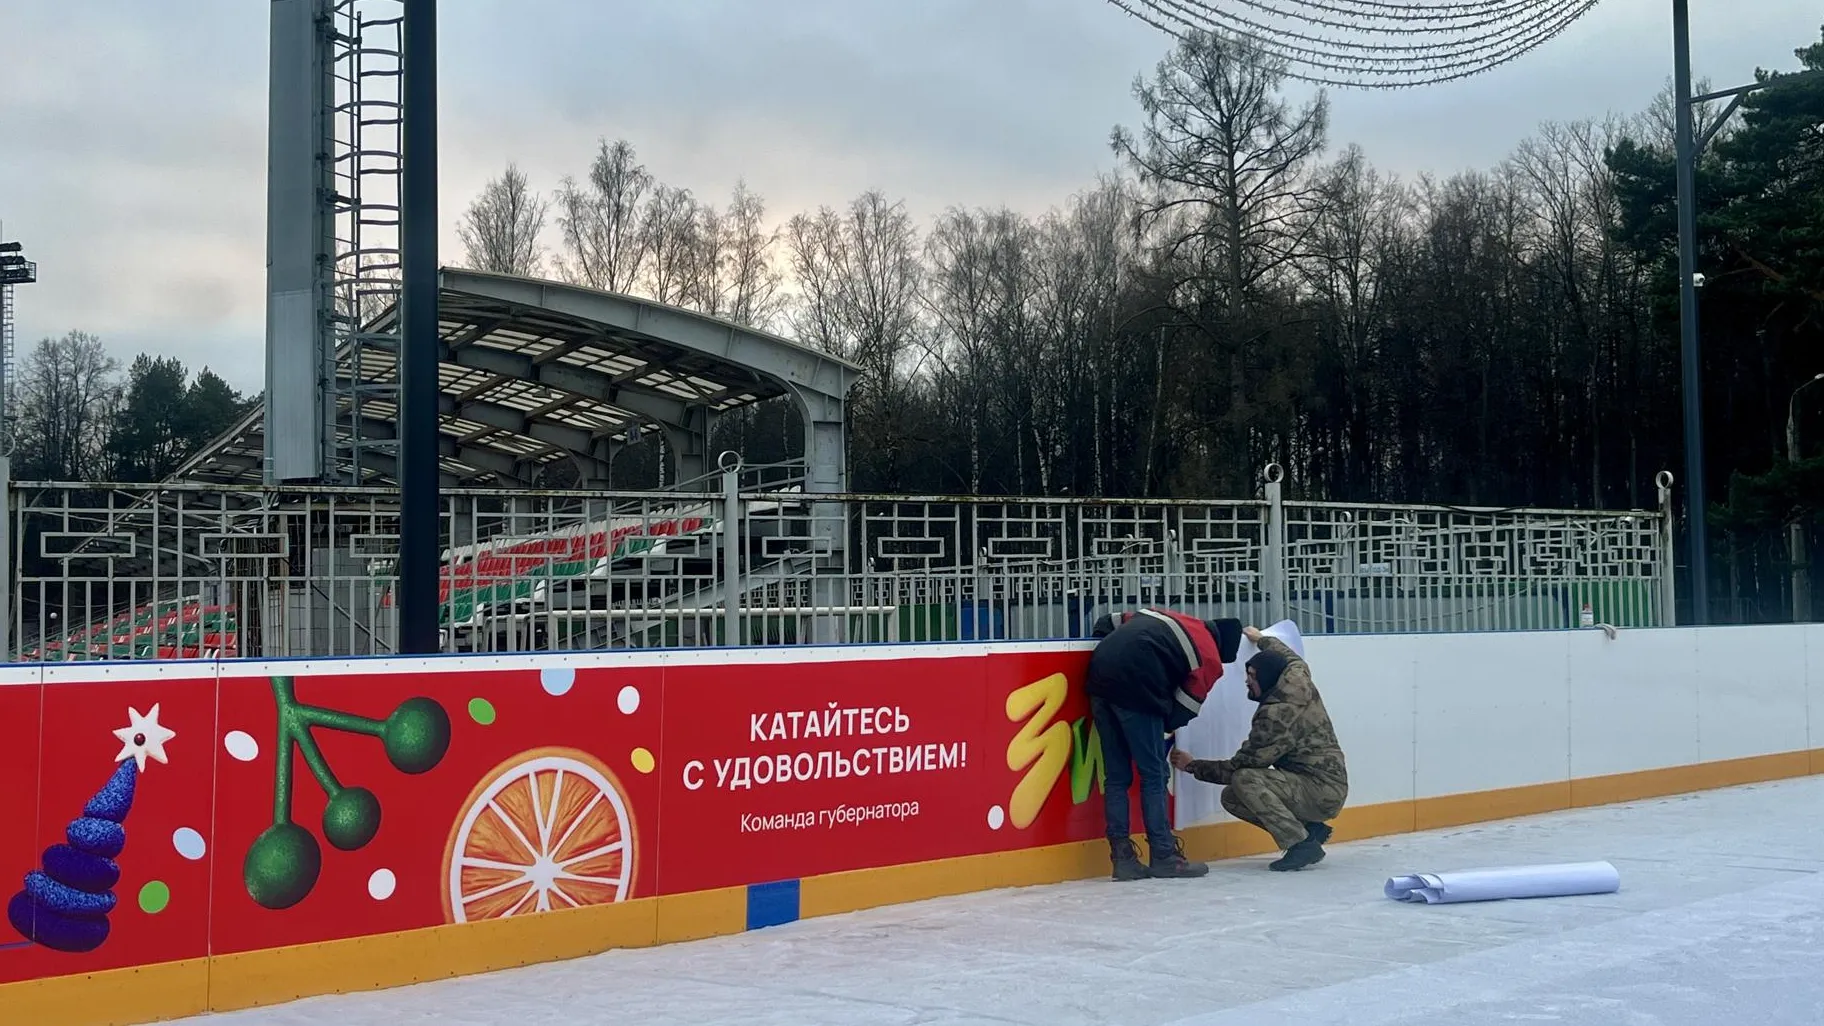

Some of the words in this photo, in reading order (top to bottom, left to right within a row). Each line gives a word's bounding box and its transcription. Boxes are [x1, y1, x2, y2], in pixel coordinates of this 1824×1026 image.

[750, 702, 910, 742] КАТАЙТЕСЬ
[682, 759, 705, 790] С
[713, 742, 967, 791] УДОВОЛЬСТВИЕМ!
[740, 811, 814, 833] Команда
[818, 799, 920, 829] губернатора
